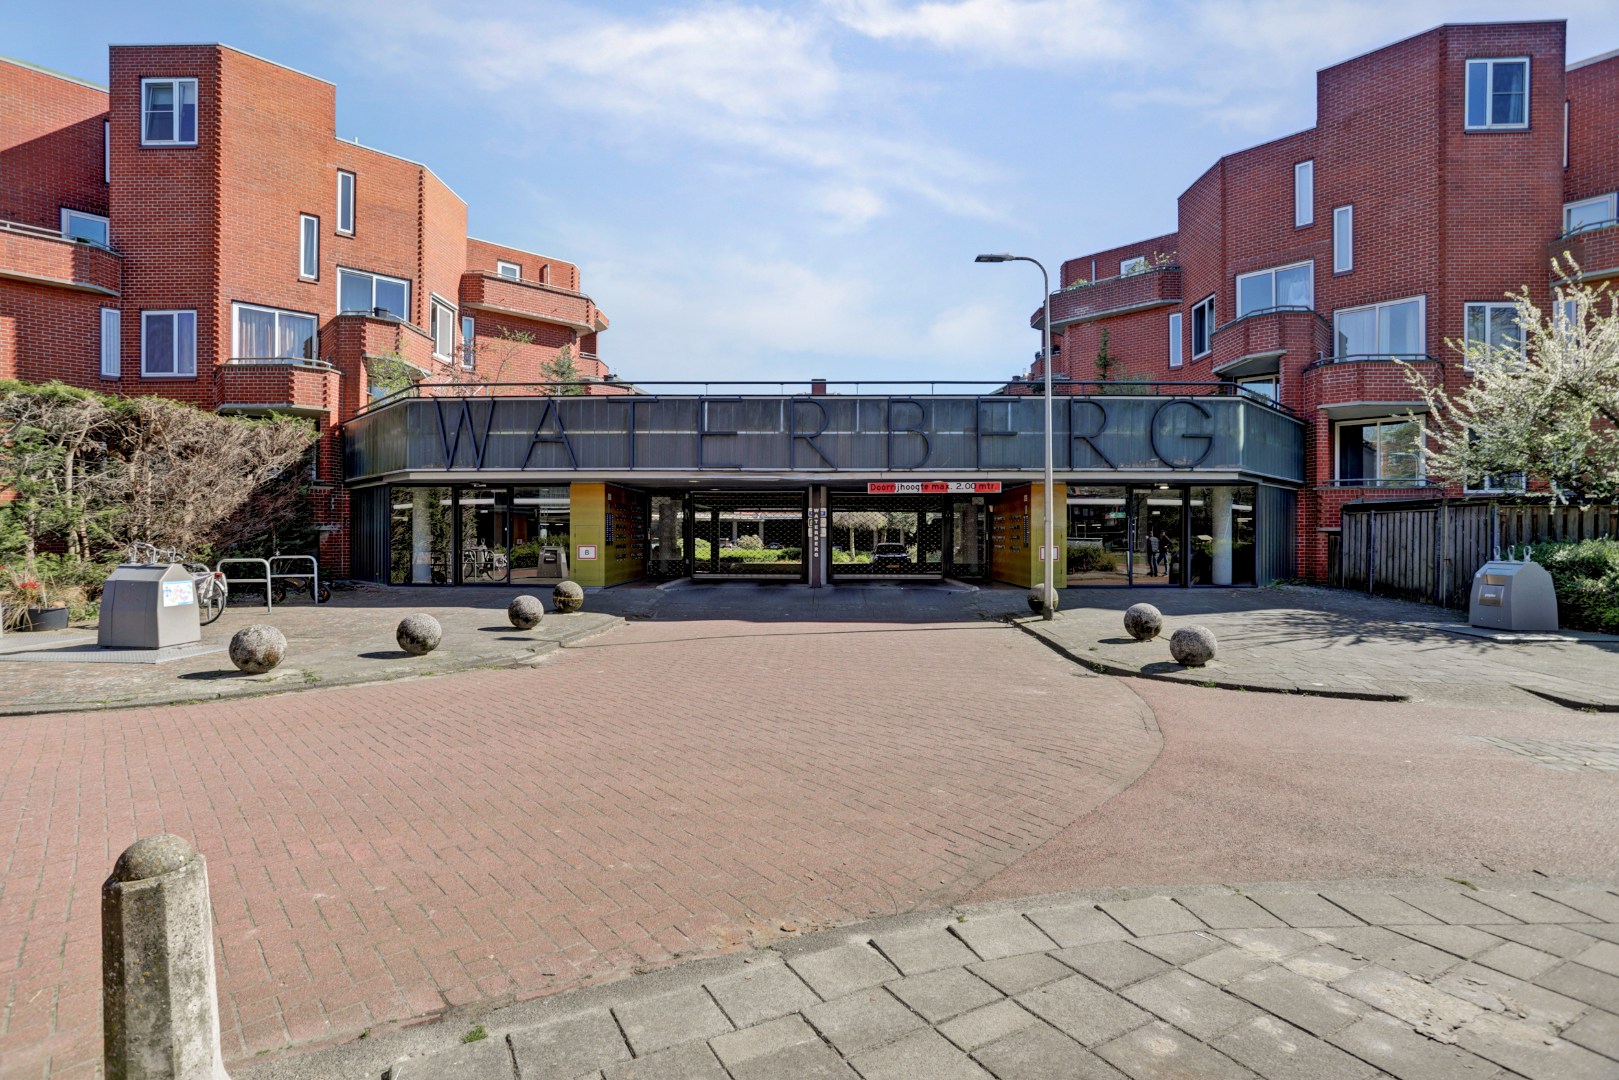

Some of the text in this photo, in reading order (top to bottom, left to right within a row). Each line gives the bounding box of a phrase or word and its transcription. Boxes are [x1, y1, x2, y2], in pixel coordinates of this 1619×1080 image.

[433, 395, 1215, 470] WATERBERG
[870, 483, 929, 492] Doorrijhoogte
[955, 482, 977, 490] 2.00
